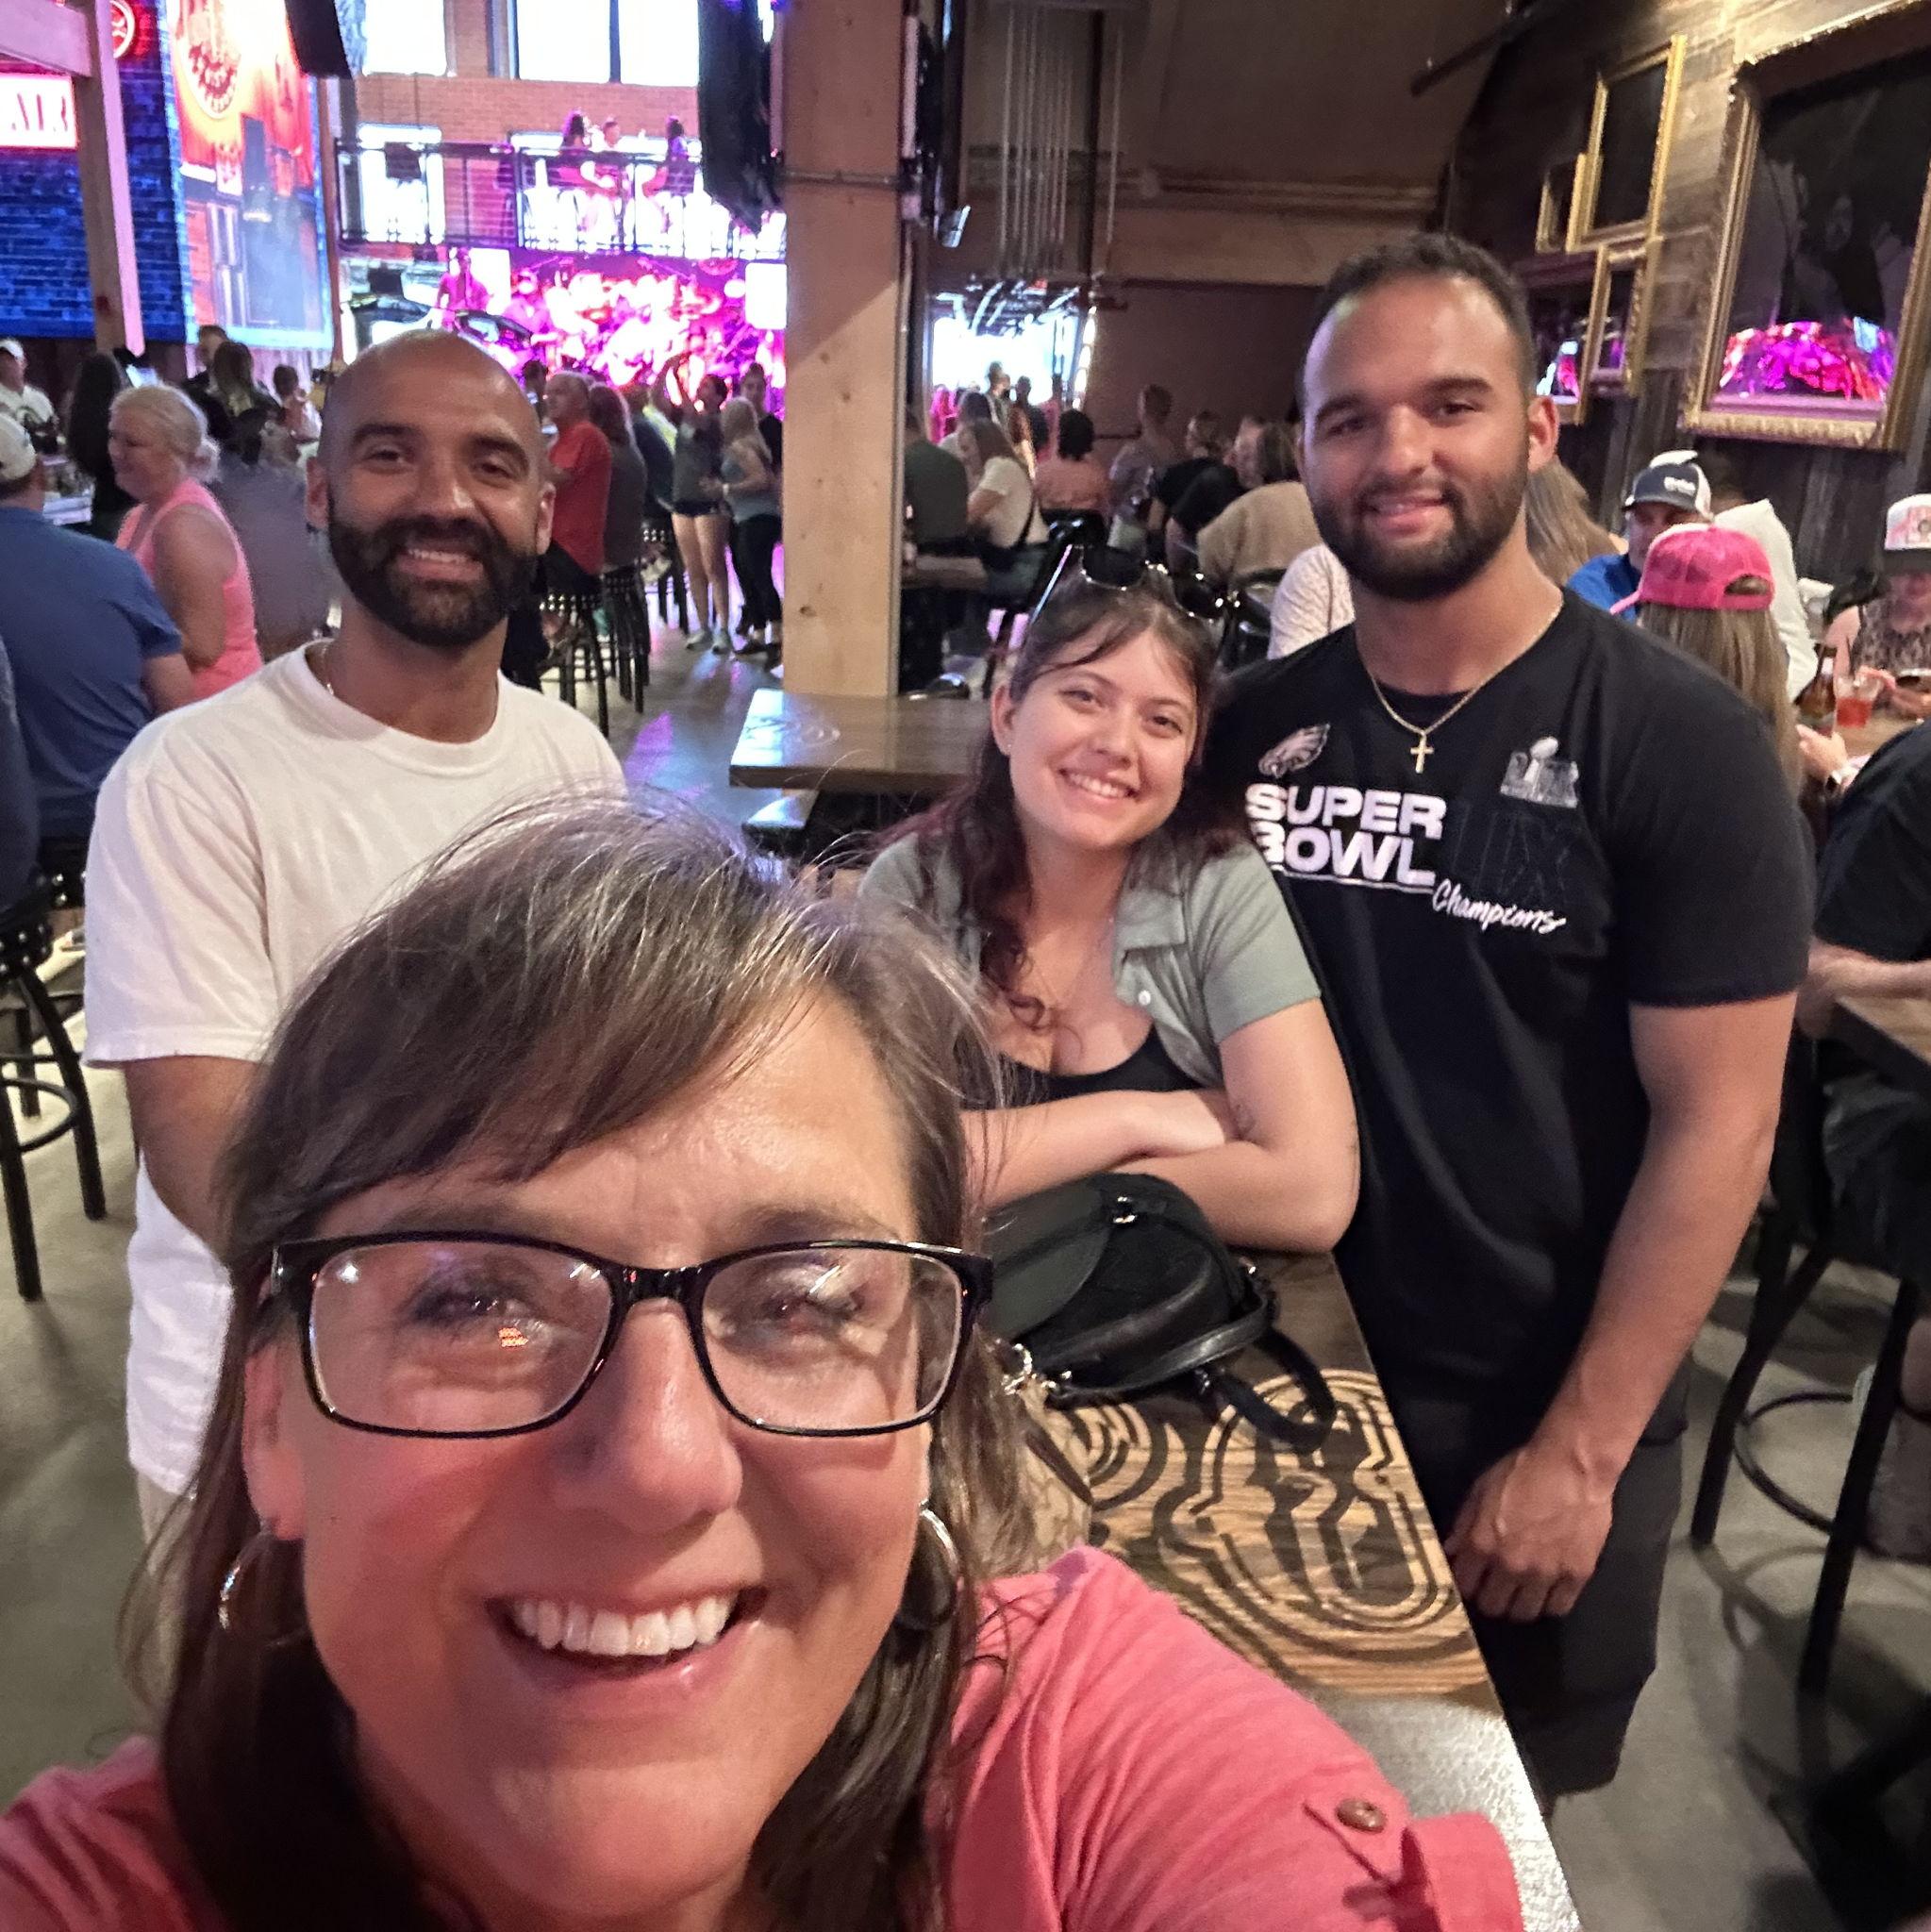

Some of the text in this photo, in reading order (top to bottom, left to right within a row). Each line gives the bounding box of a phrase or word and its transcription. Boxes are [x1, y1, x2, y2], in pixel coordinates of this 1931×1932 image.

[1245, 782, 1447, 841] SUPER
[1250, 819, 1436, 888] BOWL
[1432, 878, 1567, 935] Champions
